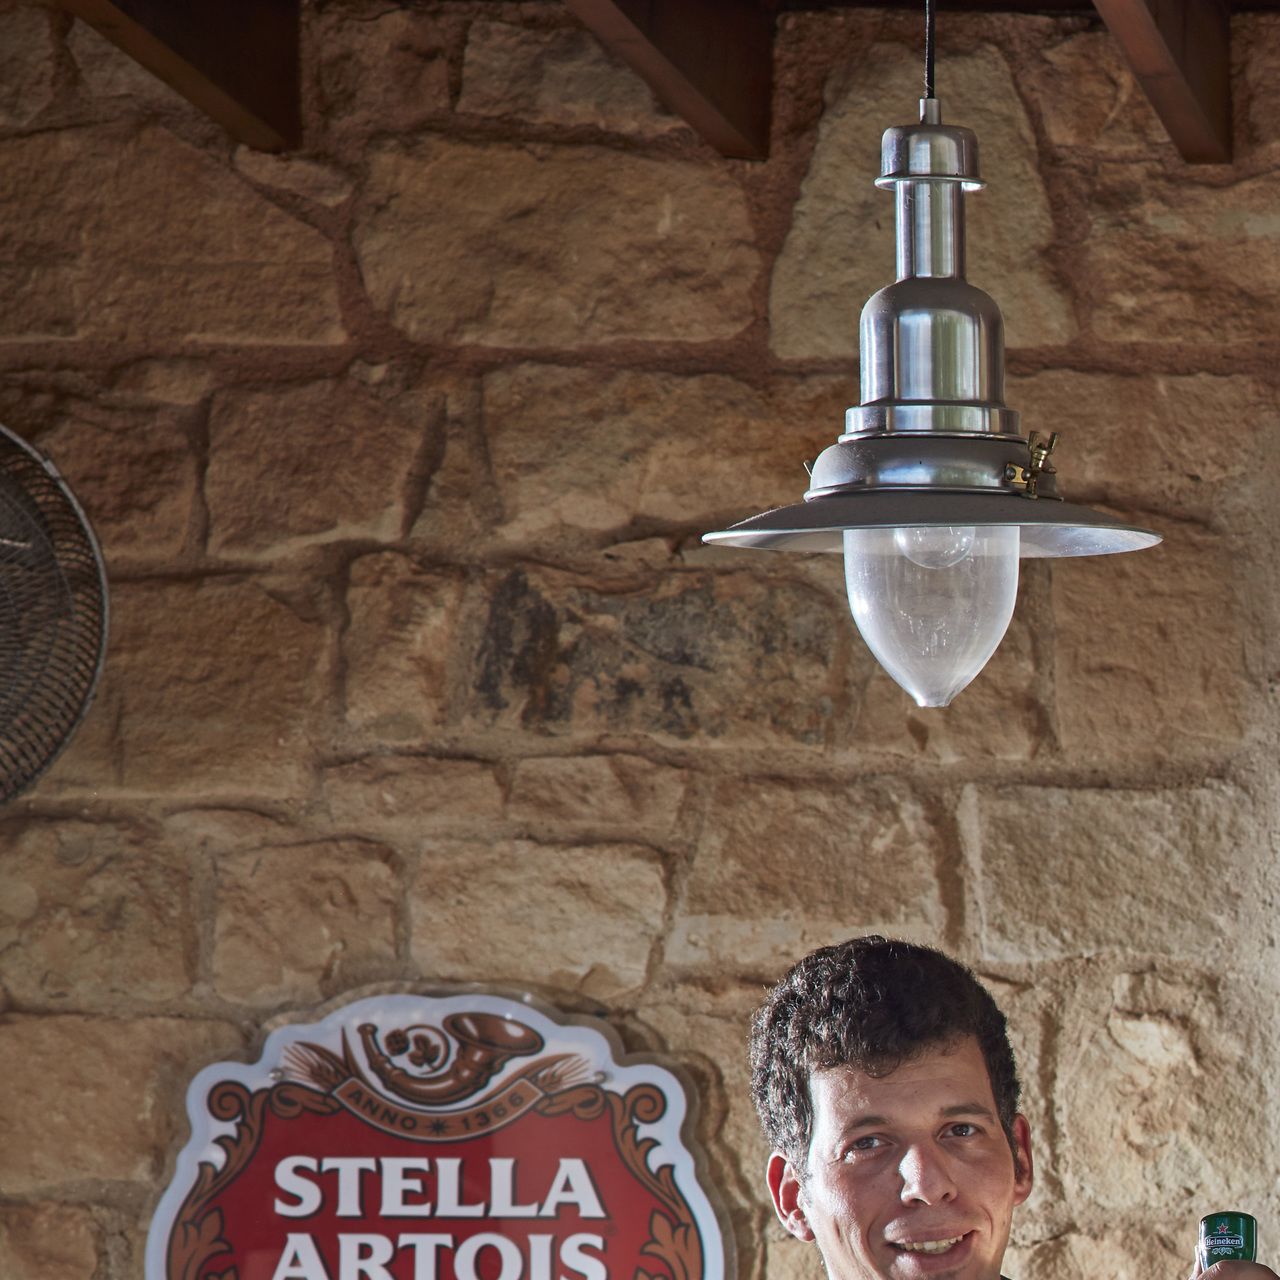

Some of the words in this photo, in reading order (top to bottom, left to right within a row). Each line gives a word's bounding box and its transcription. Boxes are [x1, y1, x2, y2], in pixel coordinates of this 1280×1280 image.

[348, 1089, 418, 1131] ANNO
[461, 1093, 524, 1131] 1366
[273, 1156, 606, 1218] STELLA
[1206, 1237, 1242, 1247] Heineken
